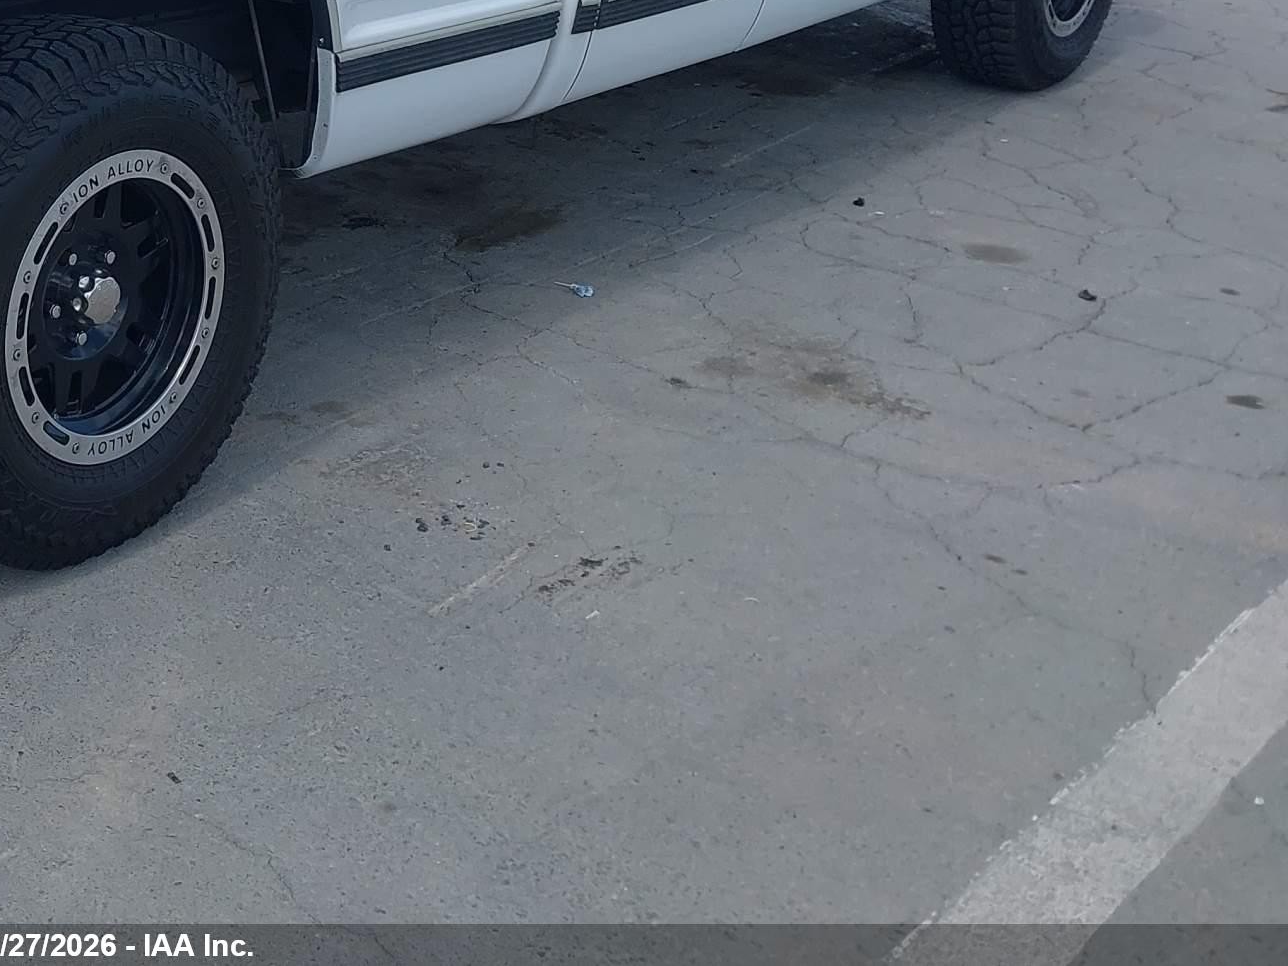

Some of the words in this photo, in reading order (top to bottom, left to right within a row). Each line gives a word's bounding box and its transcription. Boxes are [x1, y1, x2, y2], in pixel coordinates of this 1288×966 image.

[72, 174, 99, 203] ION
[107, 157, 154, 180] ALLOY
[141, 405, 166, 433] ION
[87, 429, 134, 456] ALLOY
